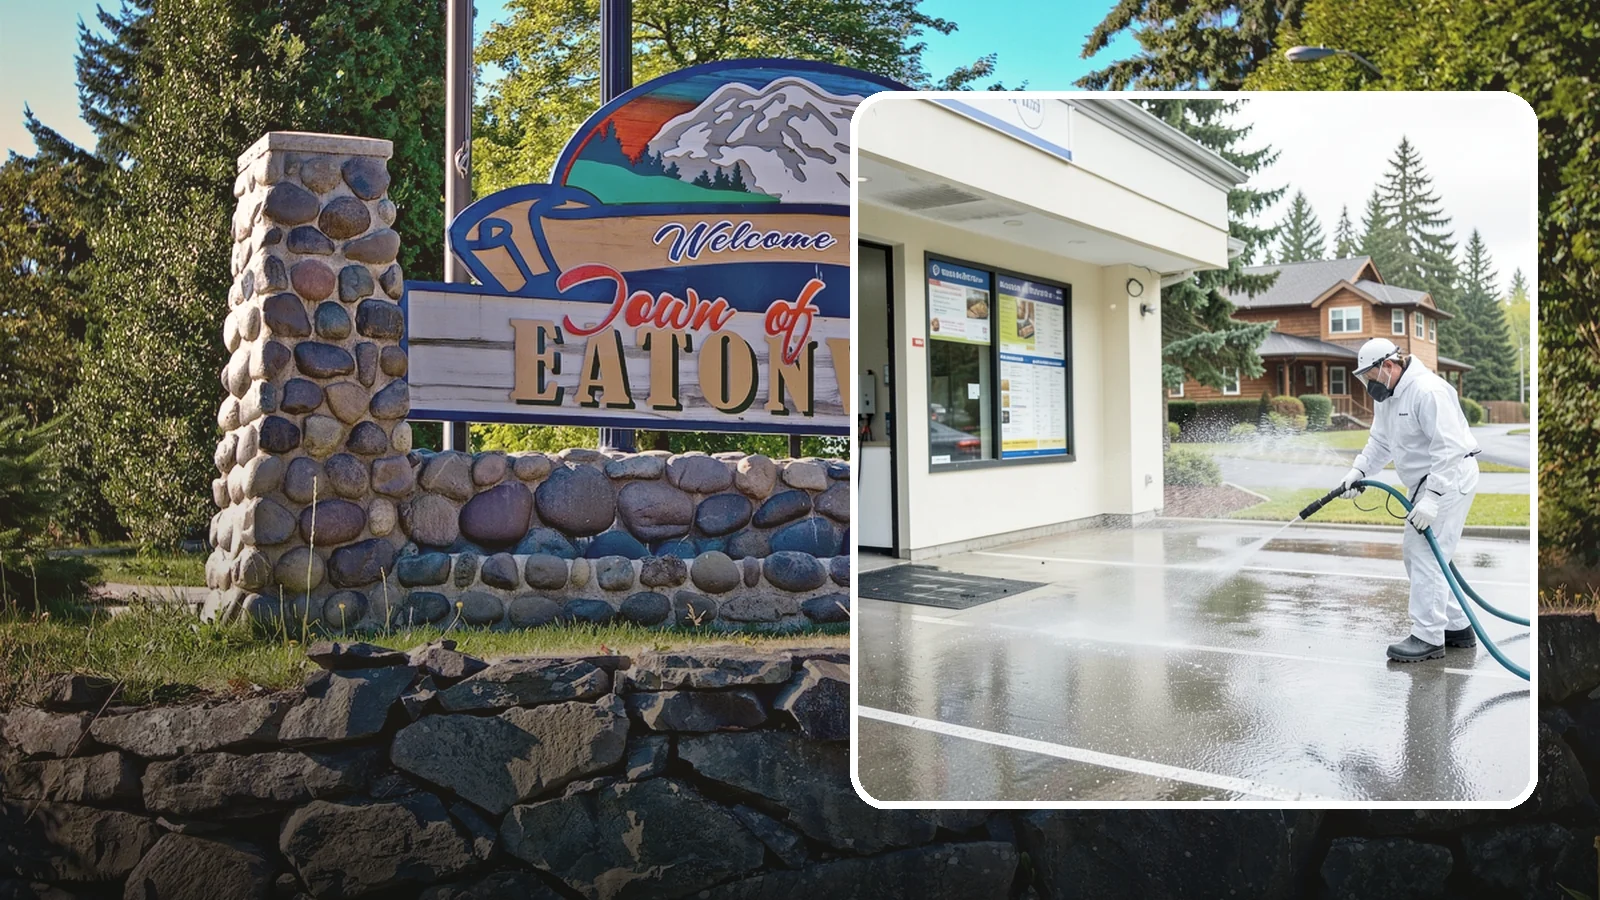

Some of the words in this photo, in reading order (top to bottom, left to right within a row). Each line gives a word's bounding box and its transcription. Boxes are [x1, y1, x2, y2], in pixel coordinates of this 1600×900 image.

[653, 220, 837, 263] Welcome
[556, 263, 737, 336] Town
[764, 278, 827, 366] of
